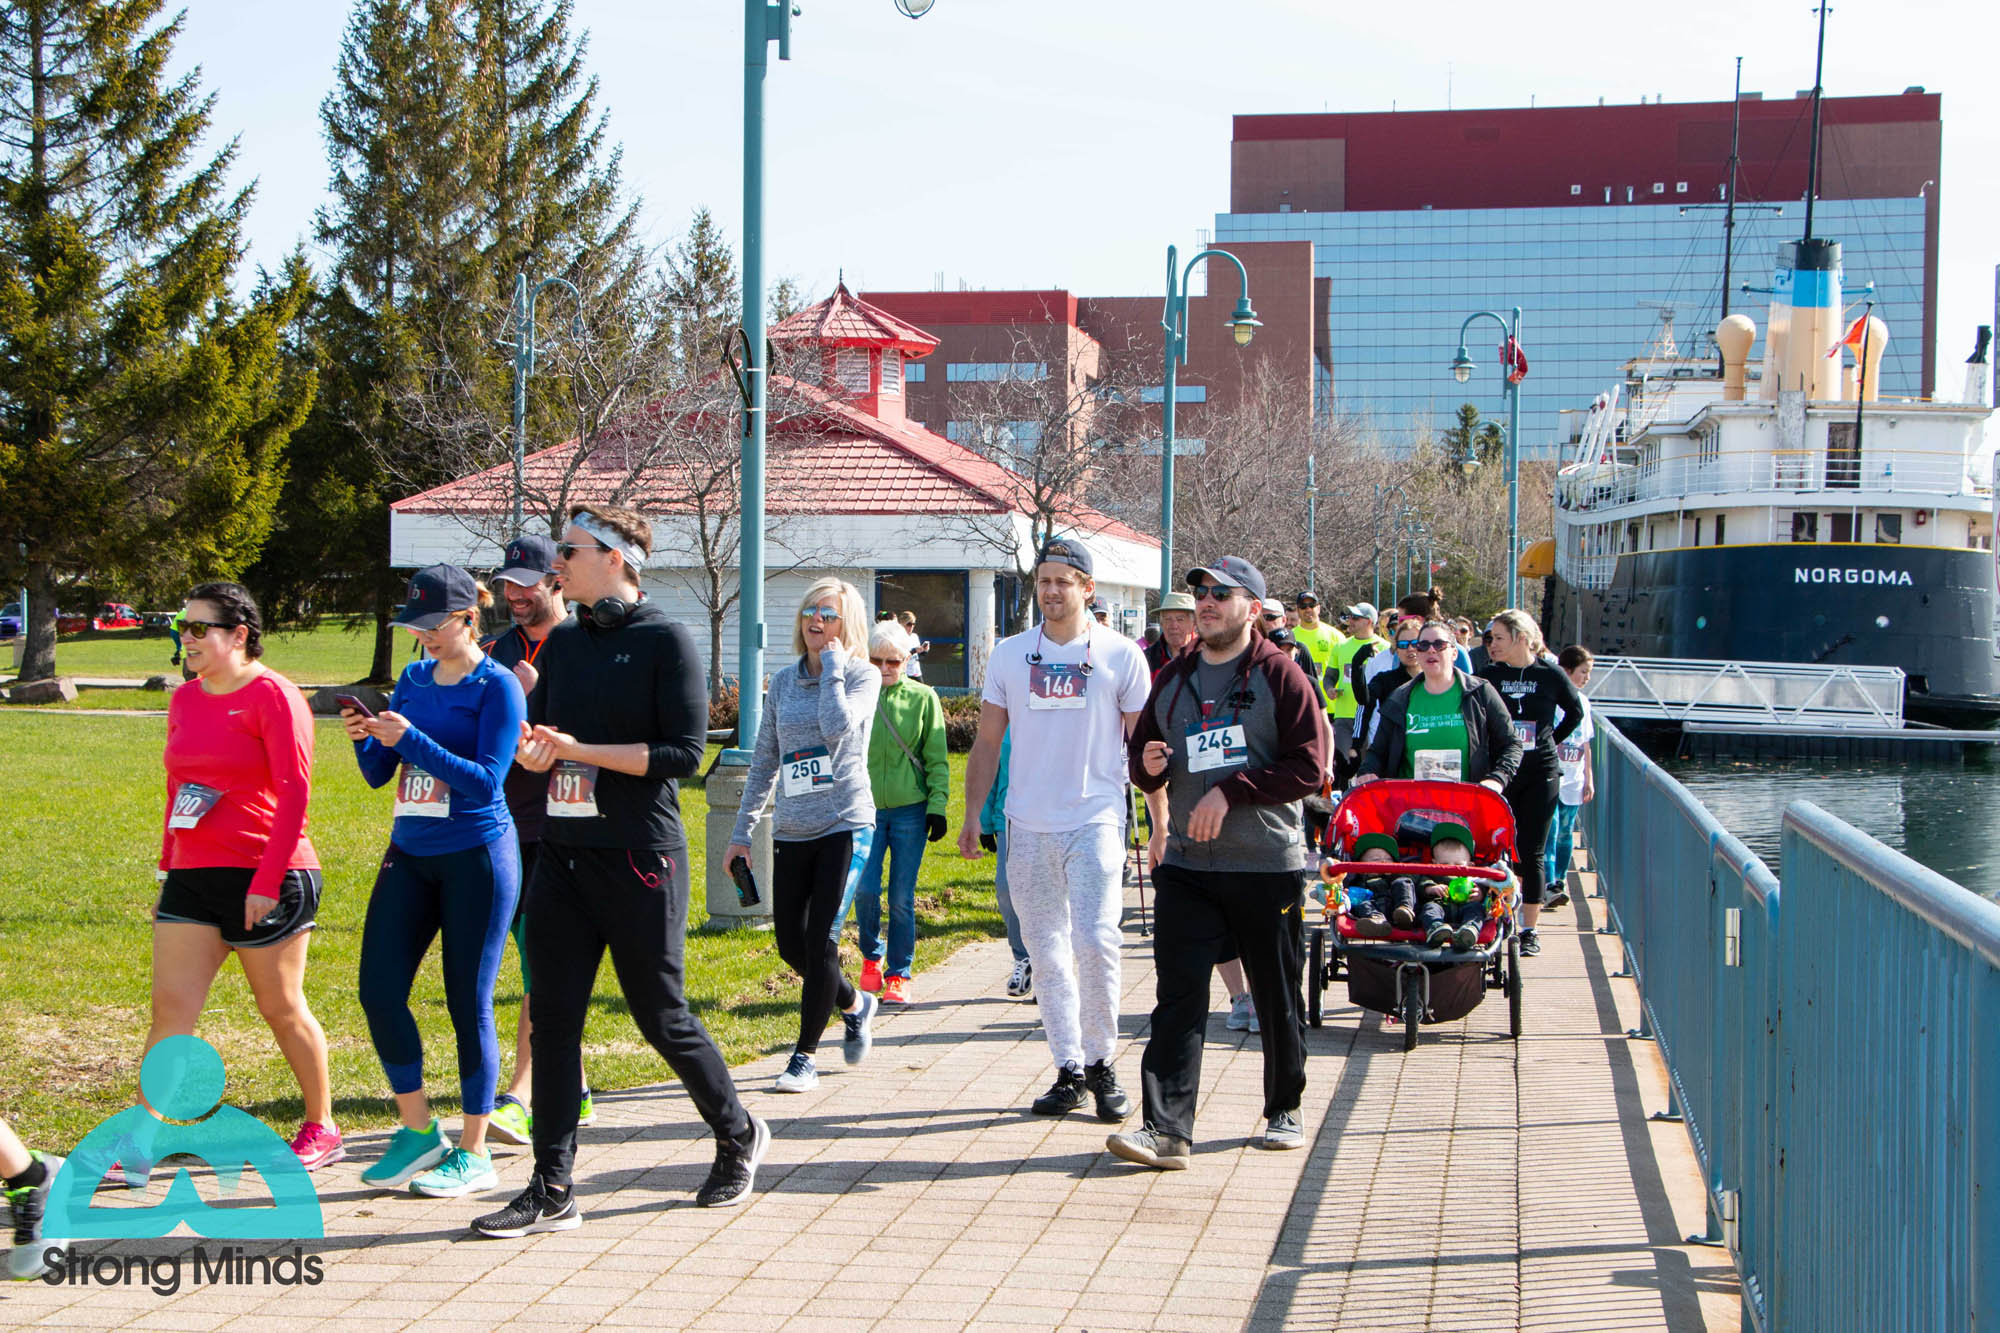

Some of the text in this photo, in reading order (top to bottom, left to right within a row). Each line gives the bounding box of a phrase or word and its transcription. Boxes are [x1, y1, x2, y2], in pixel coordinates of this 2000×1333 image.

[1794, 567, 1913, 586] NORGOMA
[1043, 675, 1073, 697] 146
[1198, 729, 1233, 752] 246
[791, 759, 820, 780] 250
[404, 776, 435, 801] 189
[556, 774, 580, 801] 191
